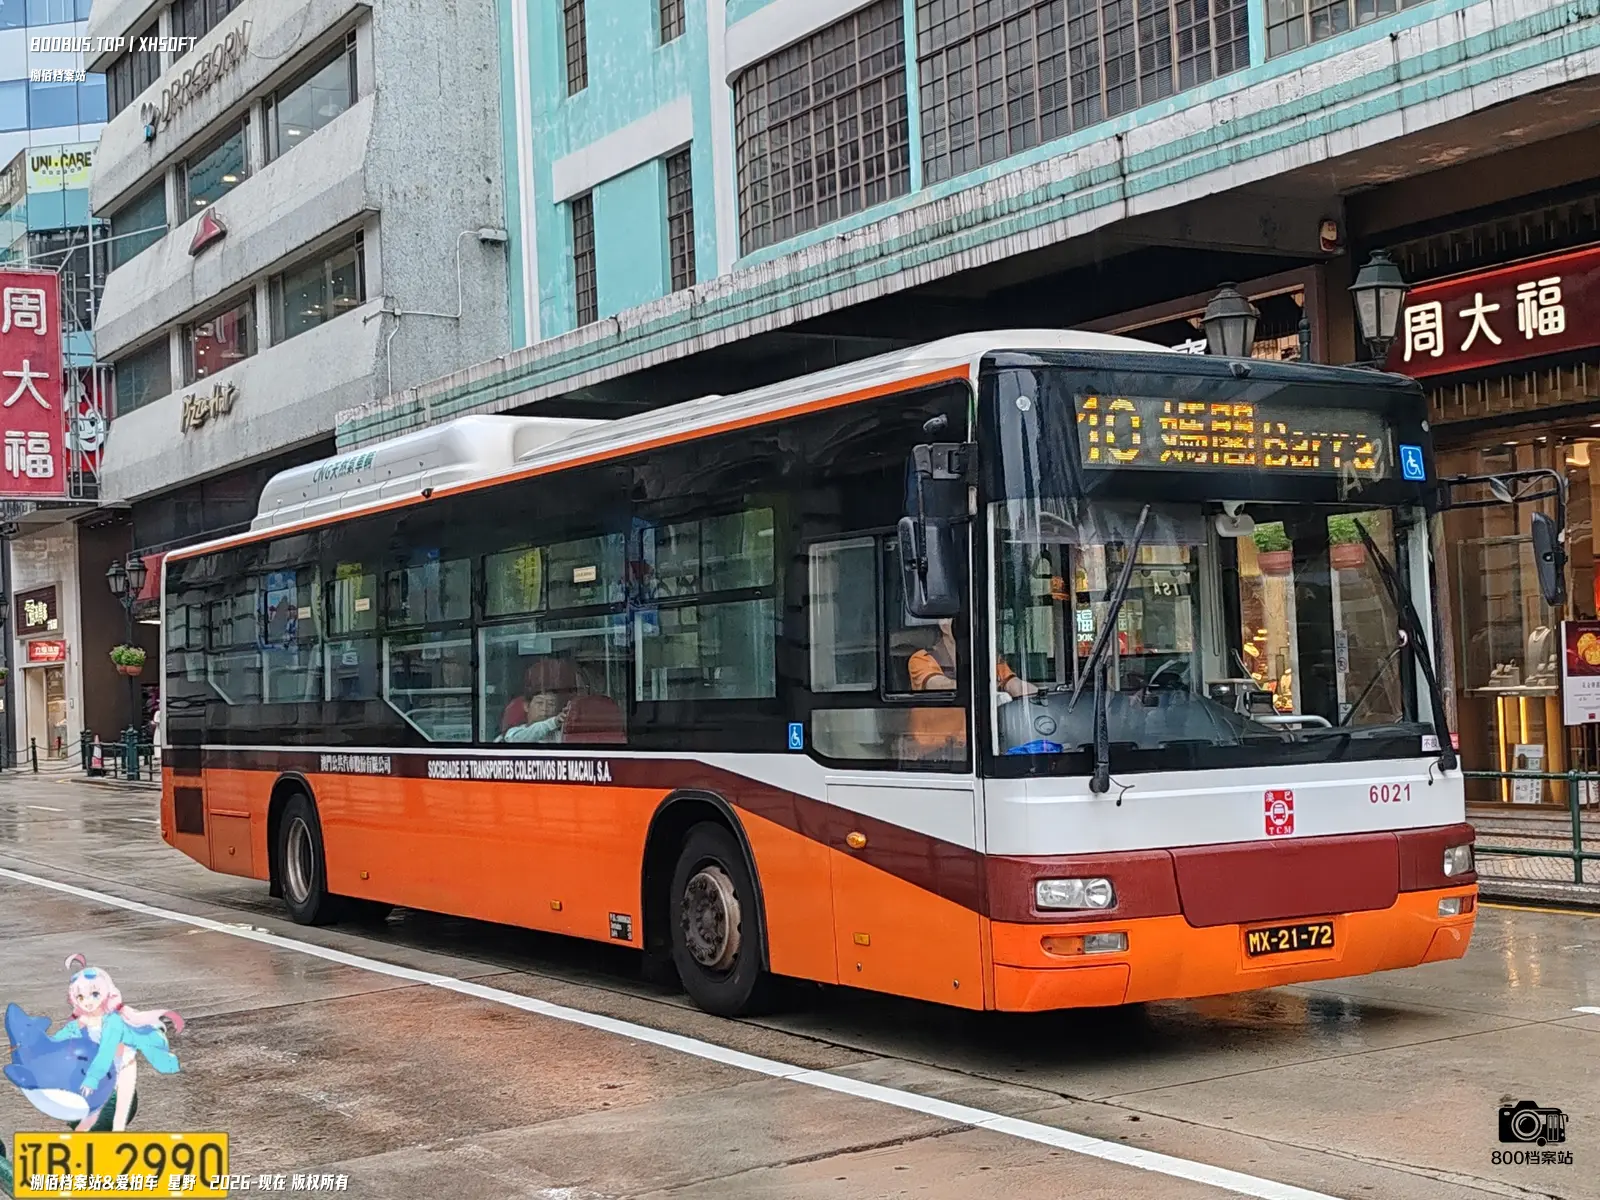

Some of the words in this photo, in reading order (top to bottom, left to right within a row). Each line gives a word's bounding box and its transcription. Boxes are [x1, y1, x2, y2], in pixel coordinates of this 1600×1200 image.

[1403, 276, 1566, 362] 周大福
[2, 286, 54, 478] 周大福
[427, 760, 460, 779] SOCIEDADE
[461, 760, 470, 779] DE
[470, 760, 514, 780] TRANSPORTES
[515, 760, 556, 781] COLECTIVOS
[557, 760, 567, 780] DE
[597, 761, 612, 782] S.A.
[1369, 783, 1411, 804] 6021
[1268, 825, 1292, 835] TCM
[1249, 925, 1332, 953] MX-21-72
